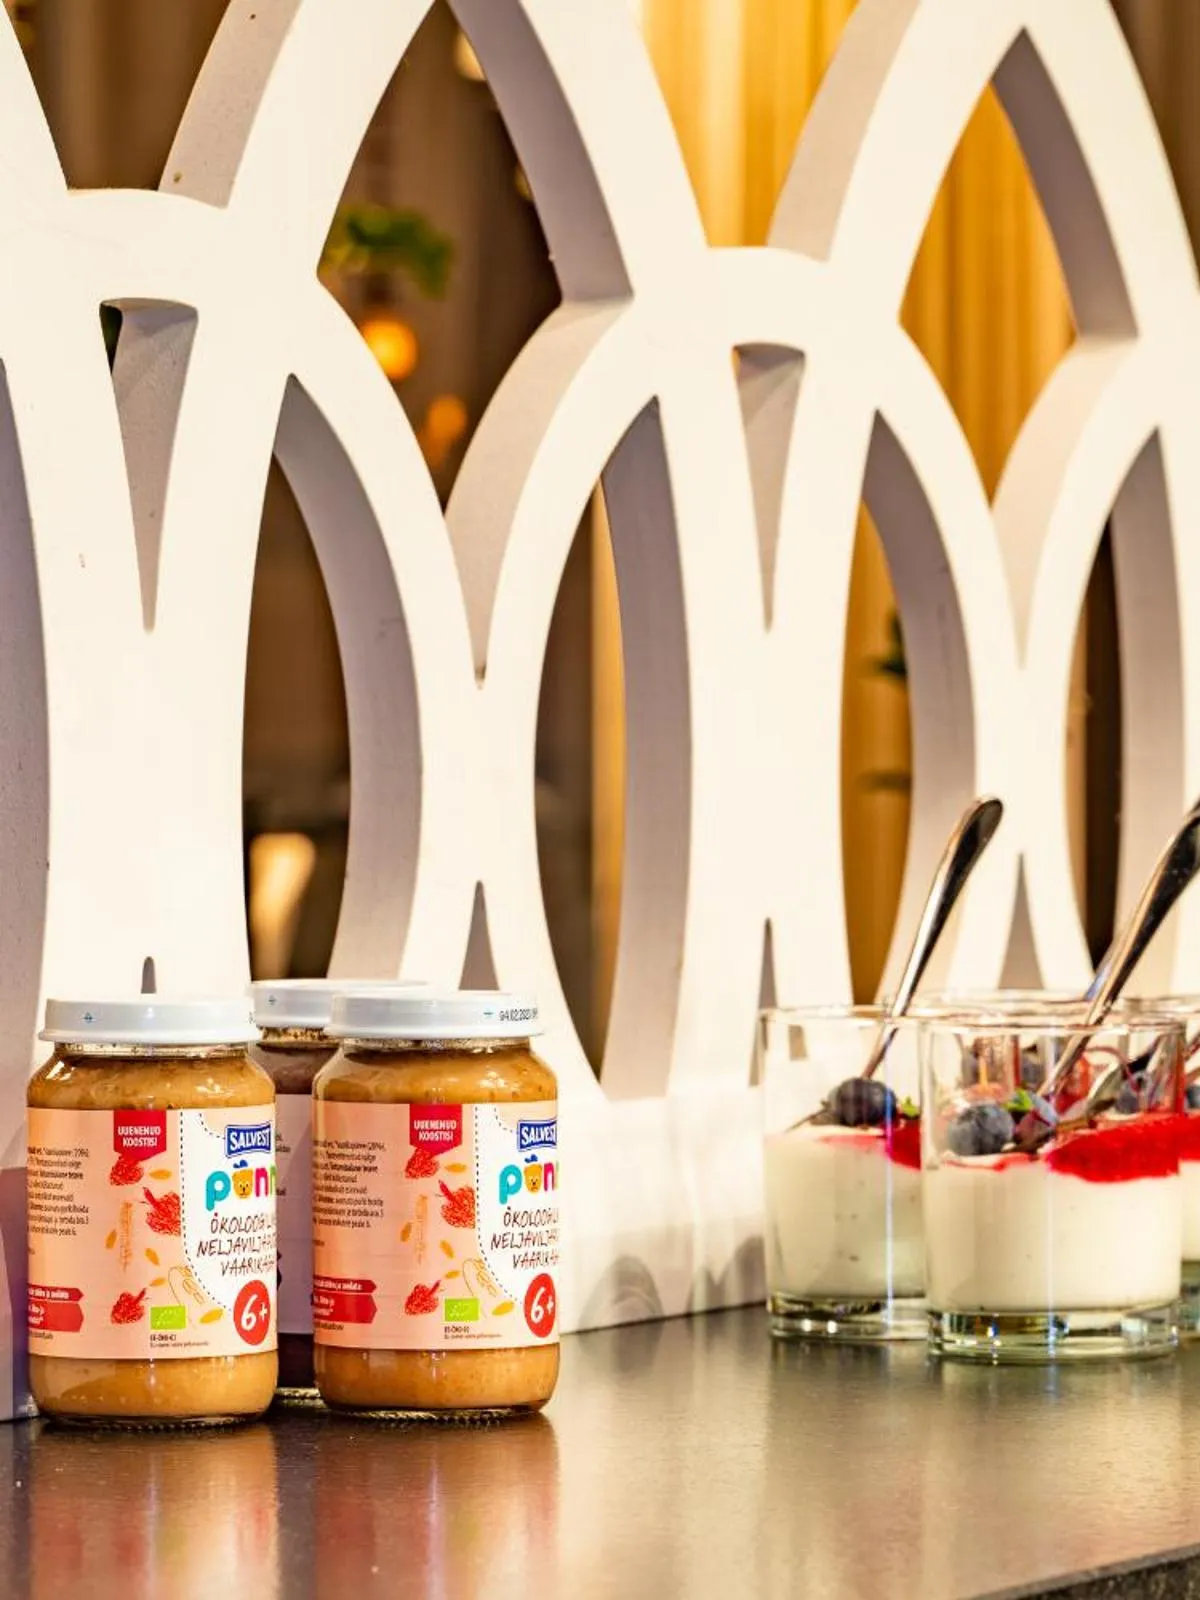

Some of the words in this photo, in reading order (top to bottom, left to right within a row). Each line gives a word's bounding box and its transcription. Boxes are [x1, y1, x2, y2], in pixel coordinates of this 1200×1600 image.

[229, 1127, 271, 1151] SALVEST
[241, 1293, 268, 1331] 6+
[530, 1286, 554, 1324] 6+
